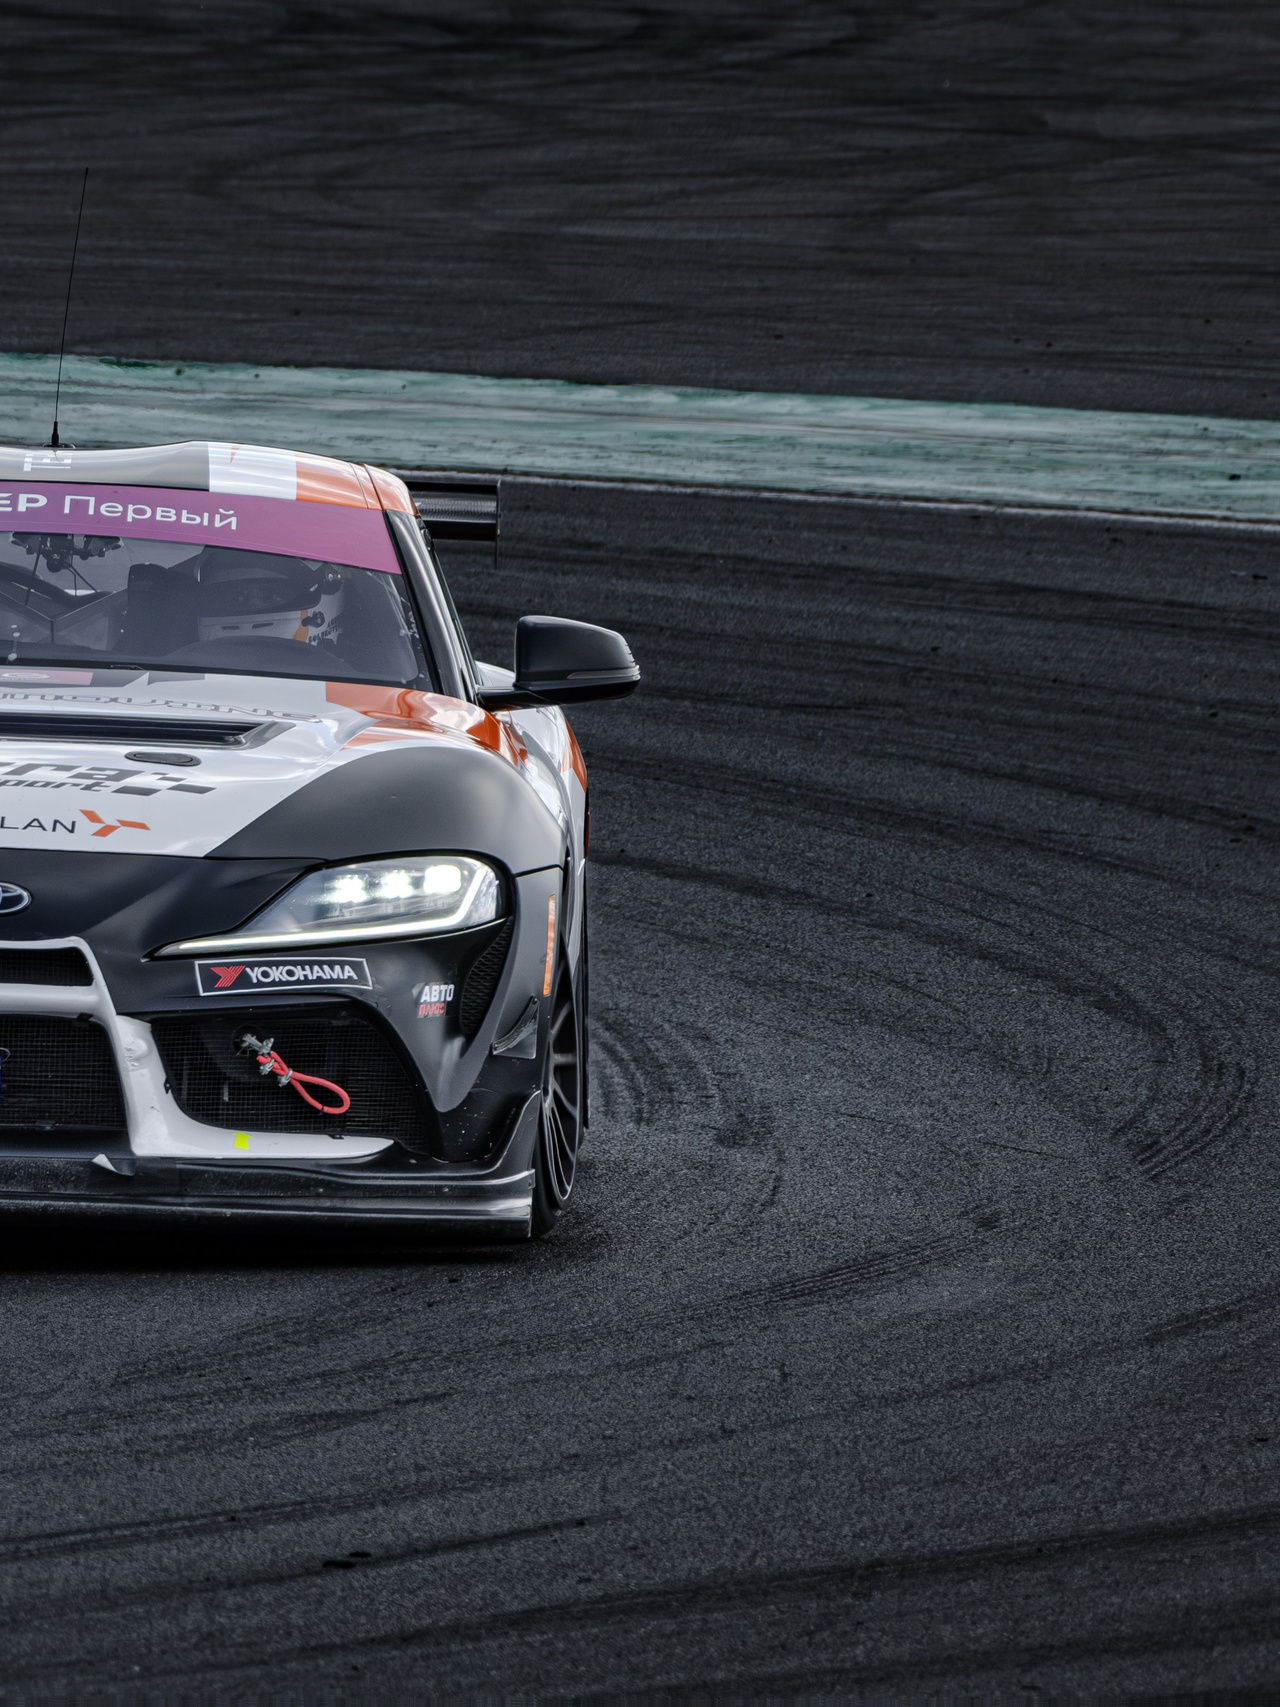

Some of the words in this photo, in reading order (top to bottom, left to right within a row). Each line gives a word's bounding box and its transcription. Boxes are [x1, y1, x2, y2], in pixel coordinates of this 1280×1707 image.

[63, 495, 238, 530] Первый
[245, 964, 358, 983] YOKOHAMA
[420, 984, 455, 1003] АВТО
